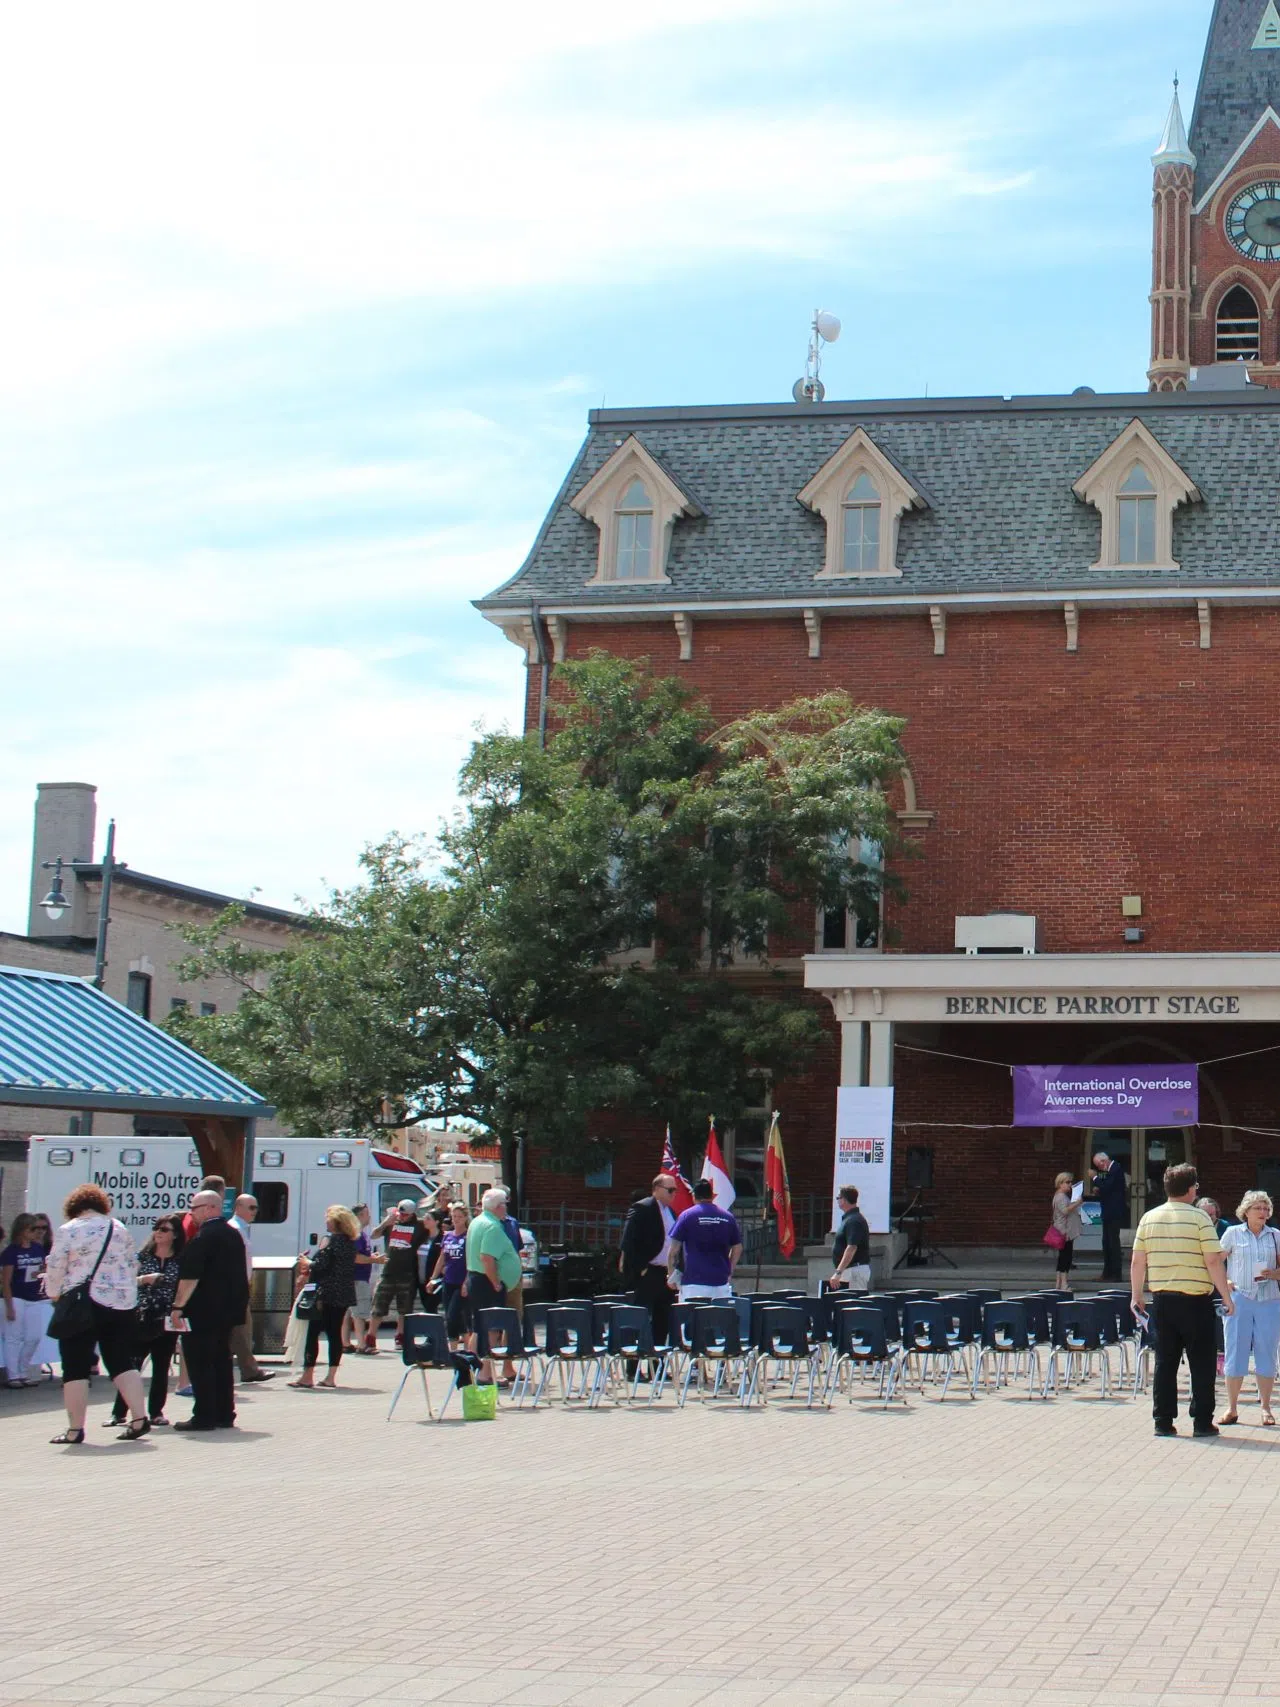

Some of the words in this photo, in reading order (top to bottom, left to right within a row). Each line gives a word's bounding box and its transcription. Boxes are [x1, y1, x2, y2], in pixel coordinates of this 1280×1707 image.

[945, 996, 1047, 1014] BERNICE
[1055, 996, 1160, 1014] PARROTT
[1167, 996, 1240, 1014] STAGE
[1044, 1078, 1125, 1091] International
[1129, 1077, 1192, 1090] Overdose
[1044, 1094, 1114, 1106] Awareness
[1117, 1093, 1142, 1107] Day
[840, 1140, 864, 1151] HARM
[94, 1171, 149, 1189] Mobile
[154, 1171, 200, 1189] Outre
[107, 1193, 195, 1209] 613.329.69
